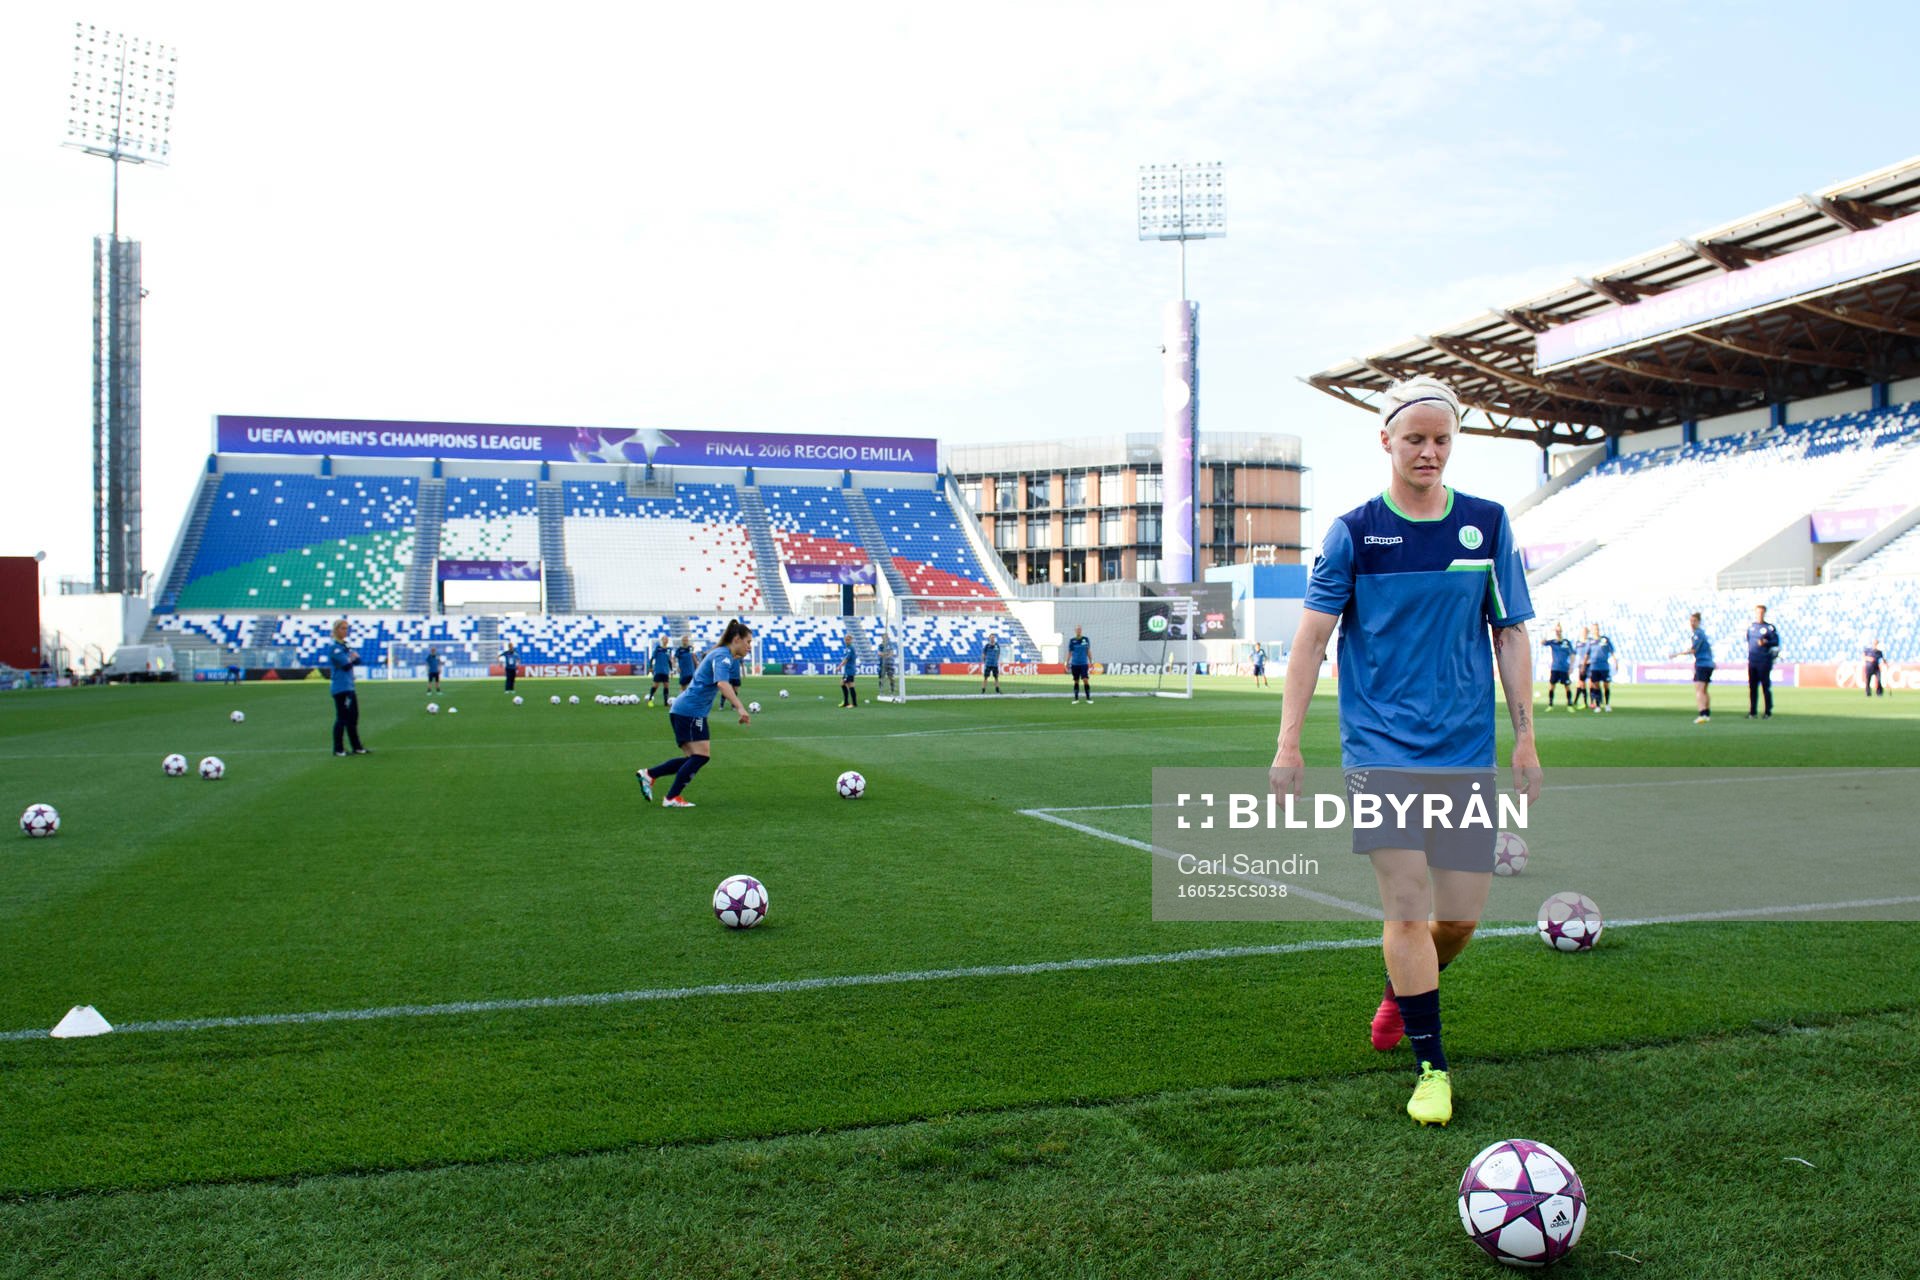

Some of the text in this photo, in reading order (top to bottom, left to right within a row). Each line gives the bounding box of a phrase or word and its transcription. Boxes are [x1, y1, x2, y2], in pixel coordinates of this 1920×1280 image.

[247, 428, 542, 450] UEFA WOMEN'S CHAMPIONS LEAGUE
[706, 443, 914, 463] FINAL 2016 REGGIO EMILIA
[1364, 536, 1403, 544] Kappa
[1207, 620, 1223, 629] OL
[525, 665, 596, 677] NISSAN
[1550, 1220, 1570, 1228] adidas
